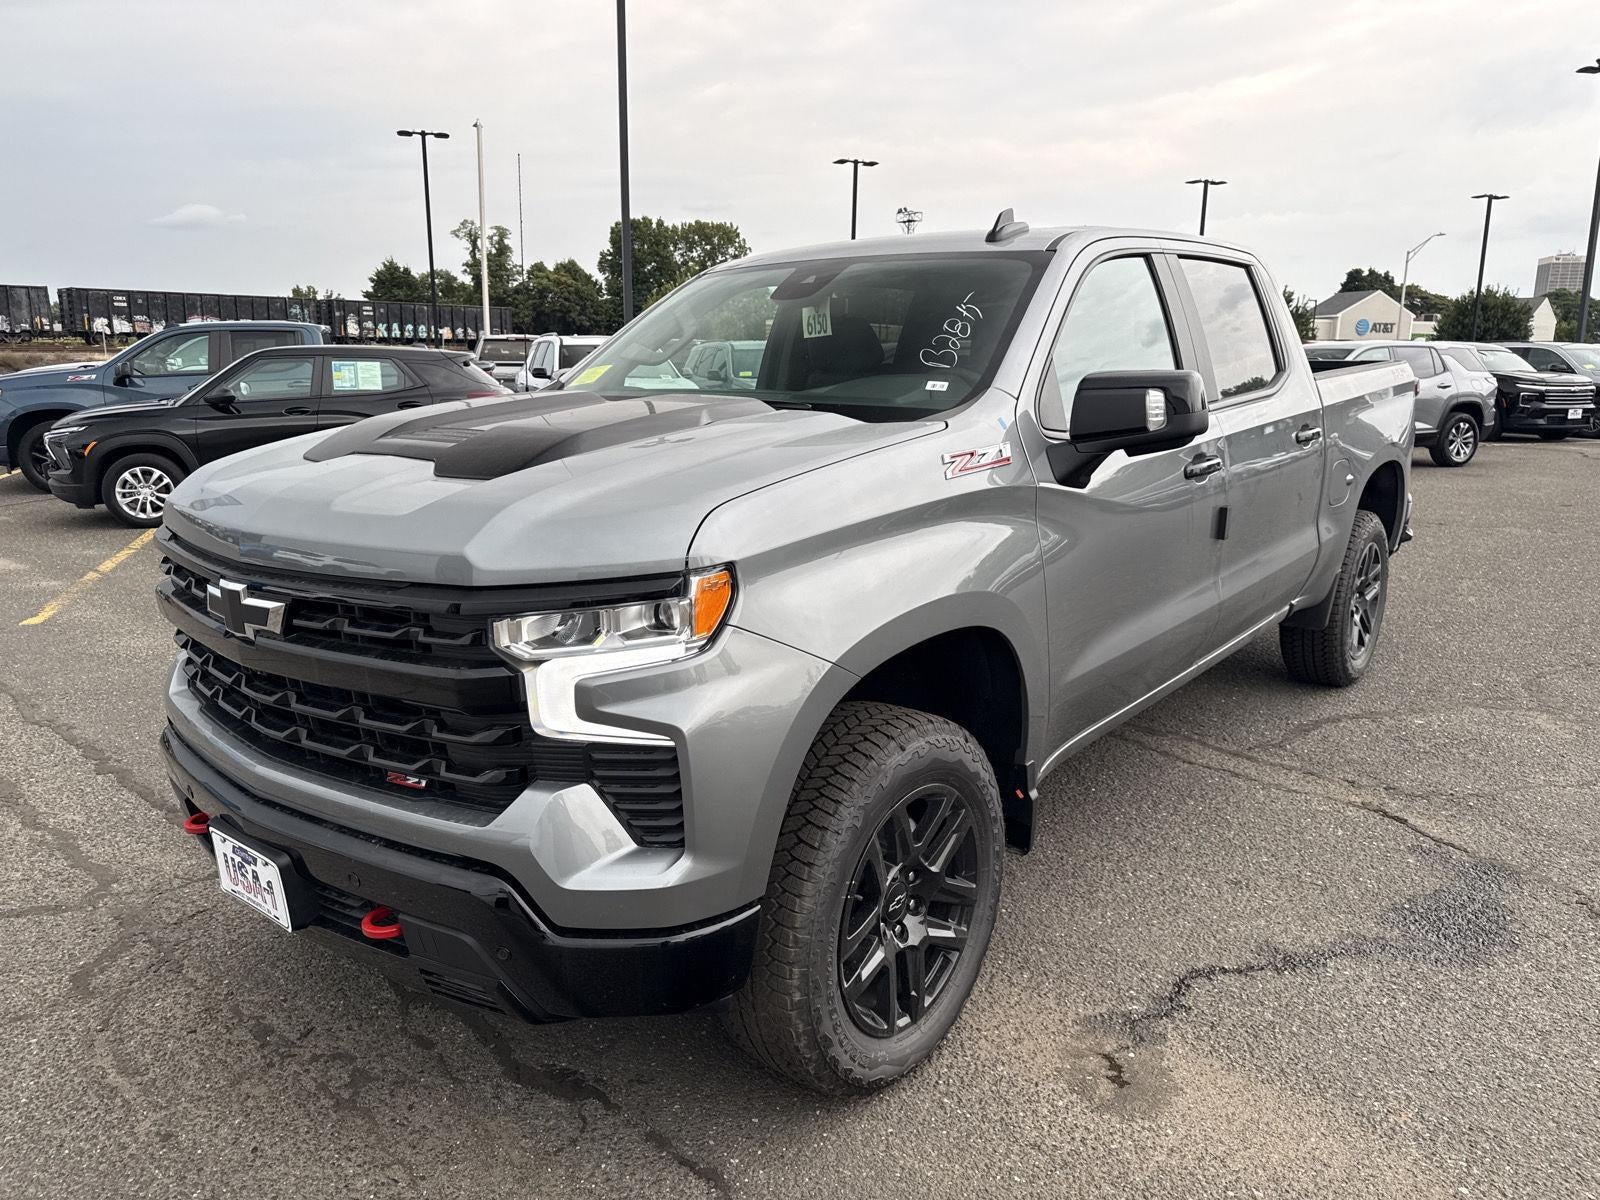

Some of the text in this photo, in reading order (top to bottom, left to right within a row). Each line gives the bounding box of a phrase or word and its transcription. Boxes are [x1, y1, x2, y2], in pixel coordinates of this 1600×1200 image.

[806, 313, 828, 336] 6150
[1370, 322, 1396, 334] AT&T
[941, 441, 1013, 481] Z71
[386, 772, 427, 789] Z71
